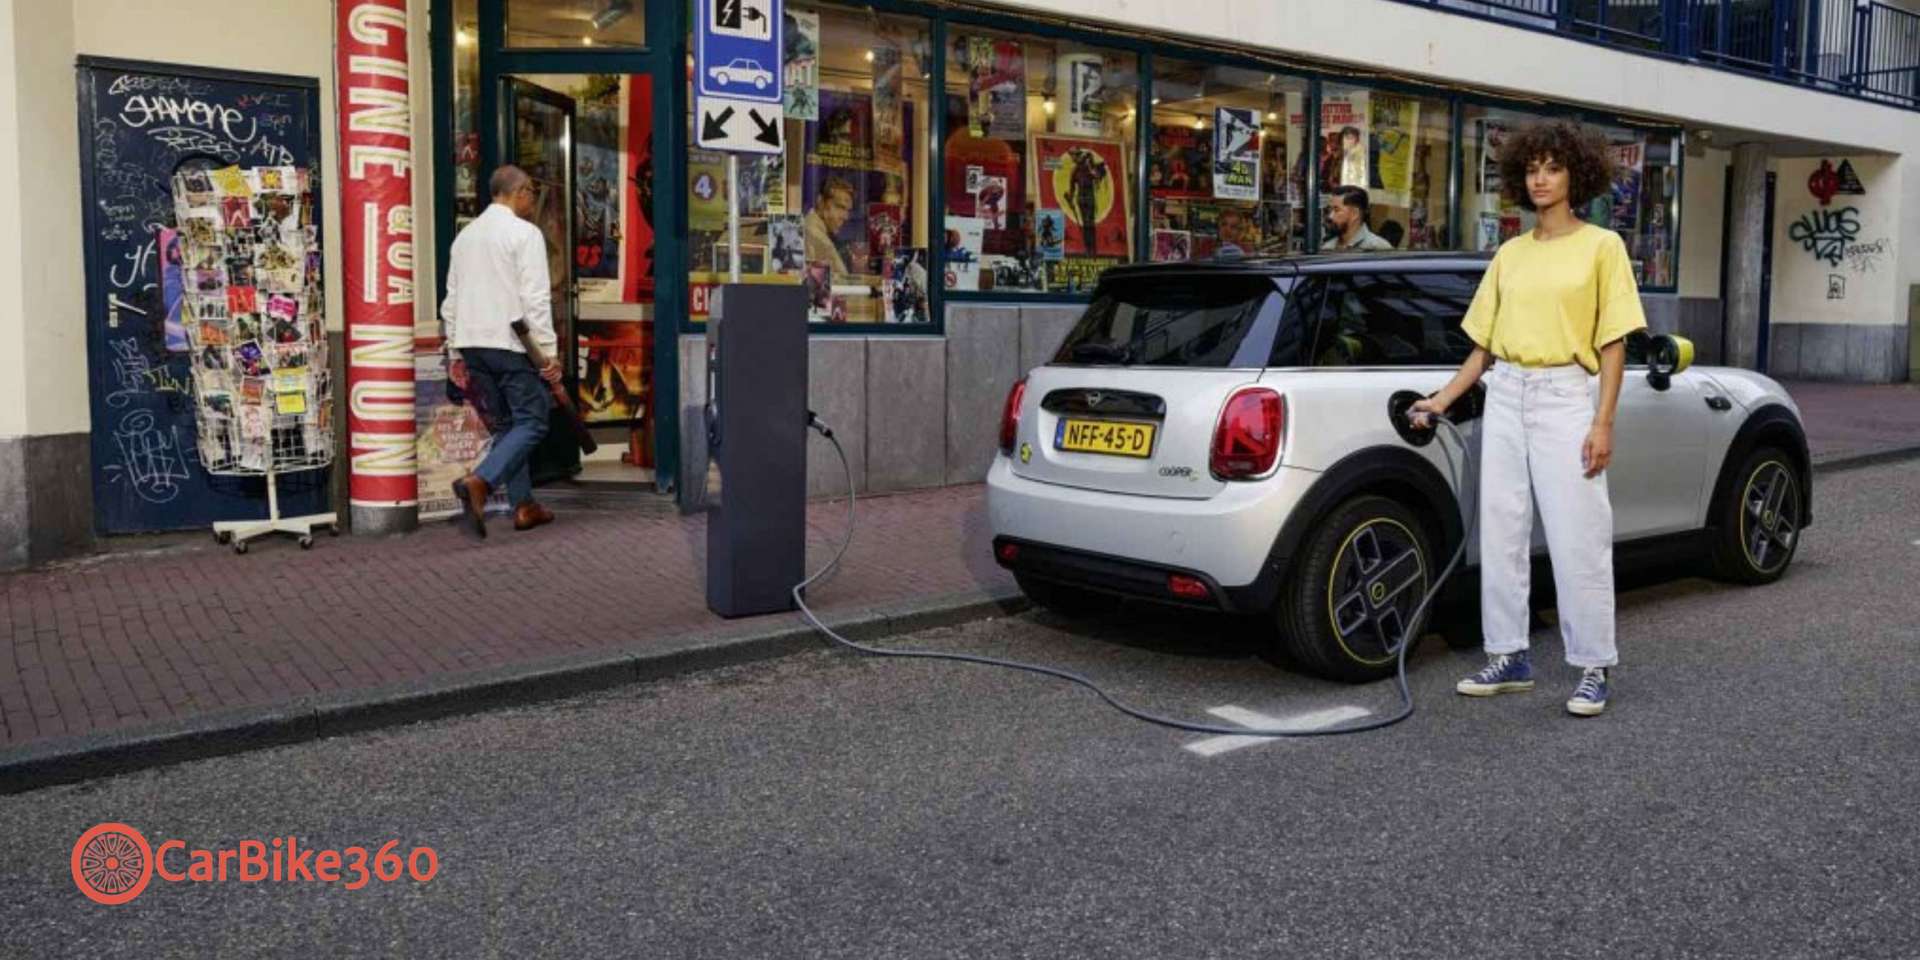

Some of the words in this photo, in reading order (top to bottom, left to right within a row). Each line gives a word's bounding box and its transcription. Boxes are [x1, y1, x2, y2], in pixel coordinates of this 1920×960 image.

[695, 175, 712, 199] 4
[692, 286, 710, 318] CI
[1067, 424, 1145, 451] NFF-45-D
